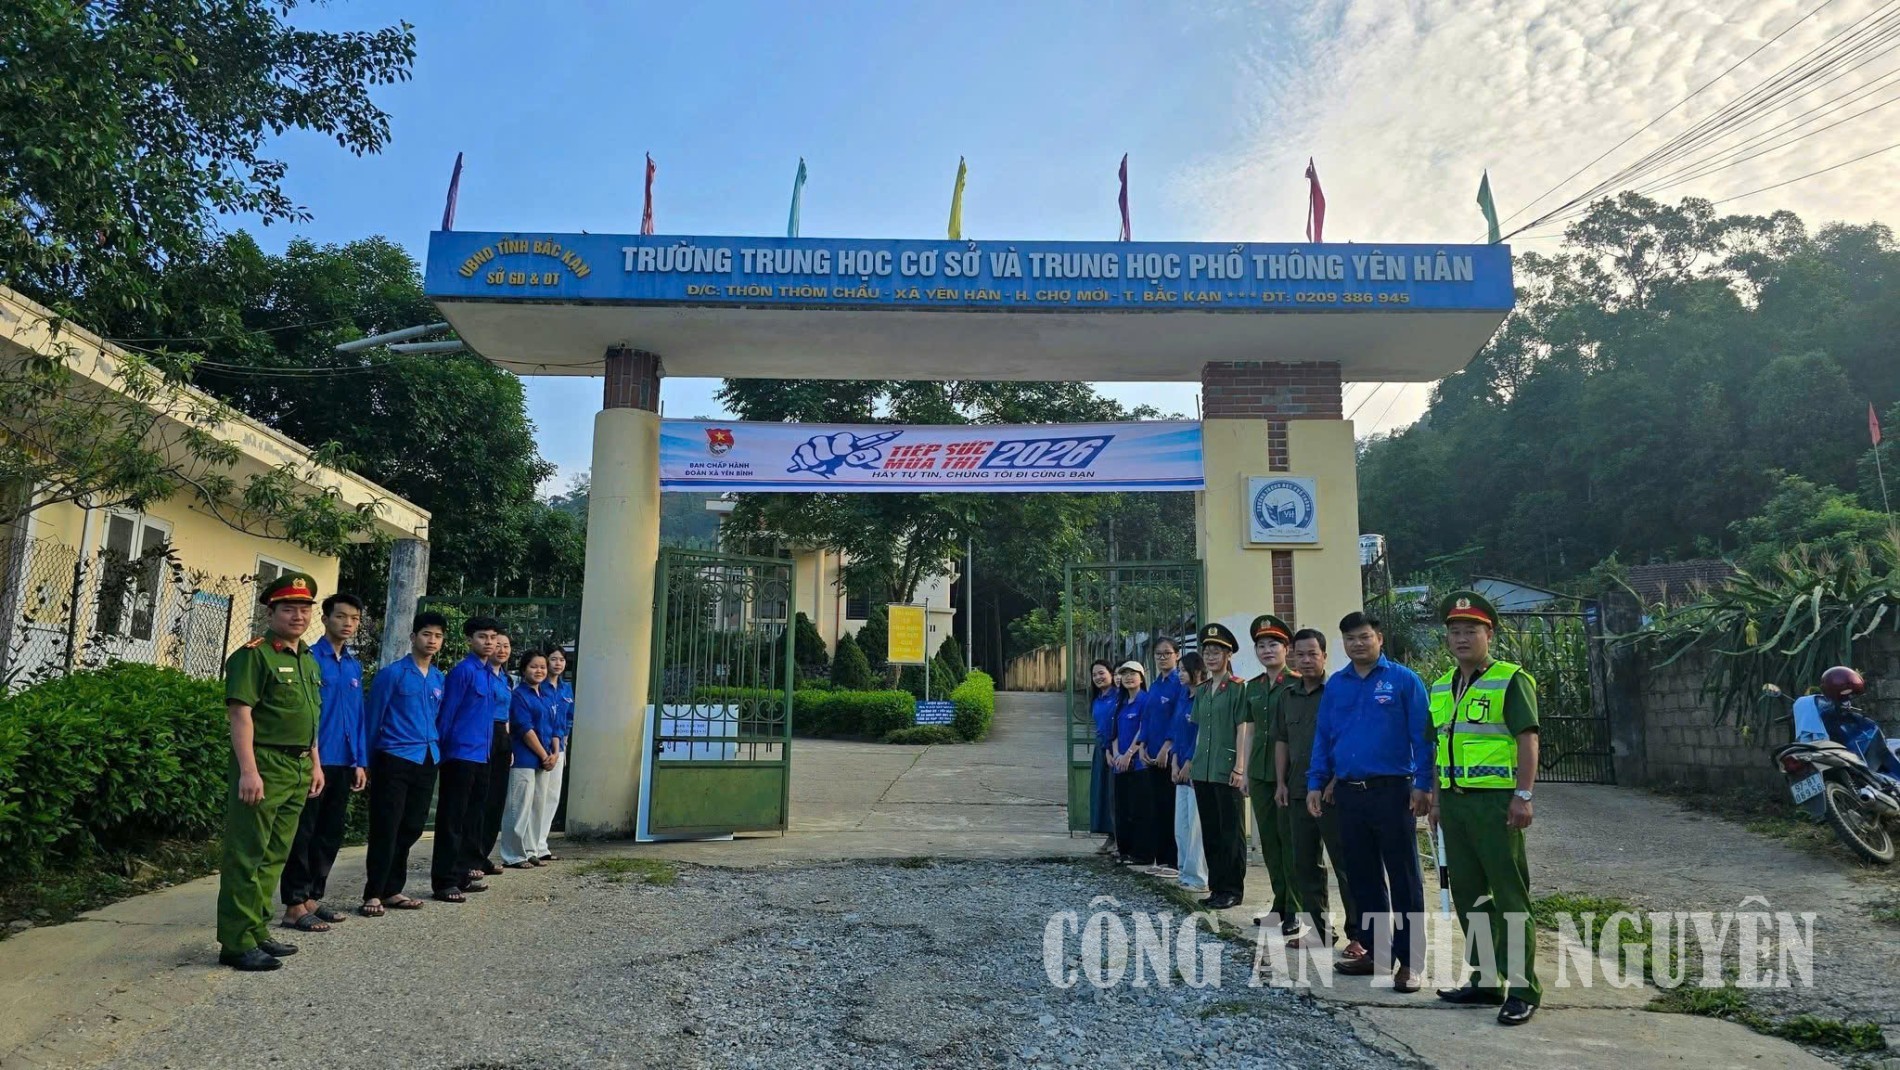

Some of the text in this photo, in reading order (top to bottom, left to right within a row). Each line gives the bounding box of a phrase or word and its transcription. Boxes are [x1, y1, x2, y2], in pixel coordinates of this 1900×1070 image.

[459, 237, 590, 278] UBND TỈNH BẮC KẠN
[622, 240, 1474, 284] TRƯỜNG TRUNG HỌC CƠ SỞ VÀ TRUNG HỌC PHỔ THÔNG YÊN HÂN
[487, 266, 505, 284] SỞ
[508, 272, 526, 284] GD
[530, 273, 539, 284] &
[687, 284, 720, 295] Đ/C:
[726, 284, 772, 296] THÔN
[778, 284, 827, 298] THÔM
[895, 286, 920, 298] XÃ
[926, 286, 958, 300] YÊN
[964, 288, 1000, 300] HÂN
[1016, 290, 1030, 300] H.
[1036, 290, 1072, 304] CHỢ
[1077, 287, 1108, 300] MỚI
[1124, 290, 1138, 300] T.
[1144, 285, 1178, 301] BẮC
[1184, 291, 1221, 304] KẠN
[1262, 292, 1290, 302] ĐT:
[1296, 292, 1337, 302] 0209
[1343, 292, 1374, 302] 386
[1378, 292, 1410, 302] 945
[890, 440, 994, 457] TIẾP SỨC
[986, 438, 1104, 467] 2026
[941, 456, 982, 470] THI
[902, 471, 917, 479] TỰ
[994, 470, 1012, 478] TÔI
[1070, 471, 1095, 479] BẠN
